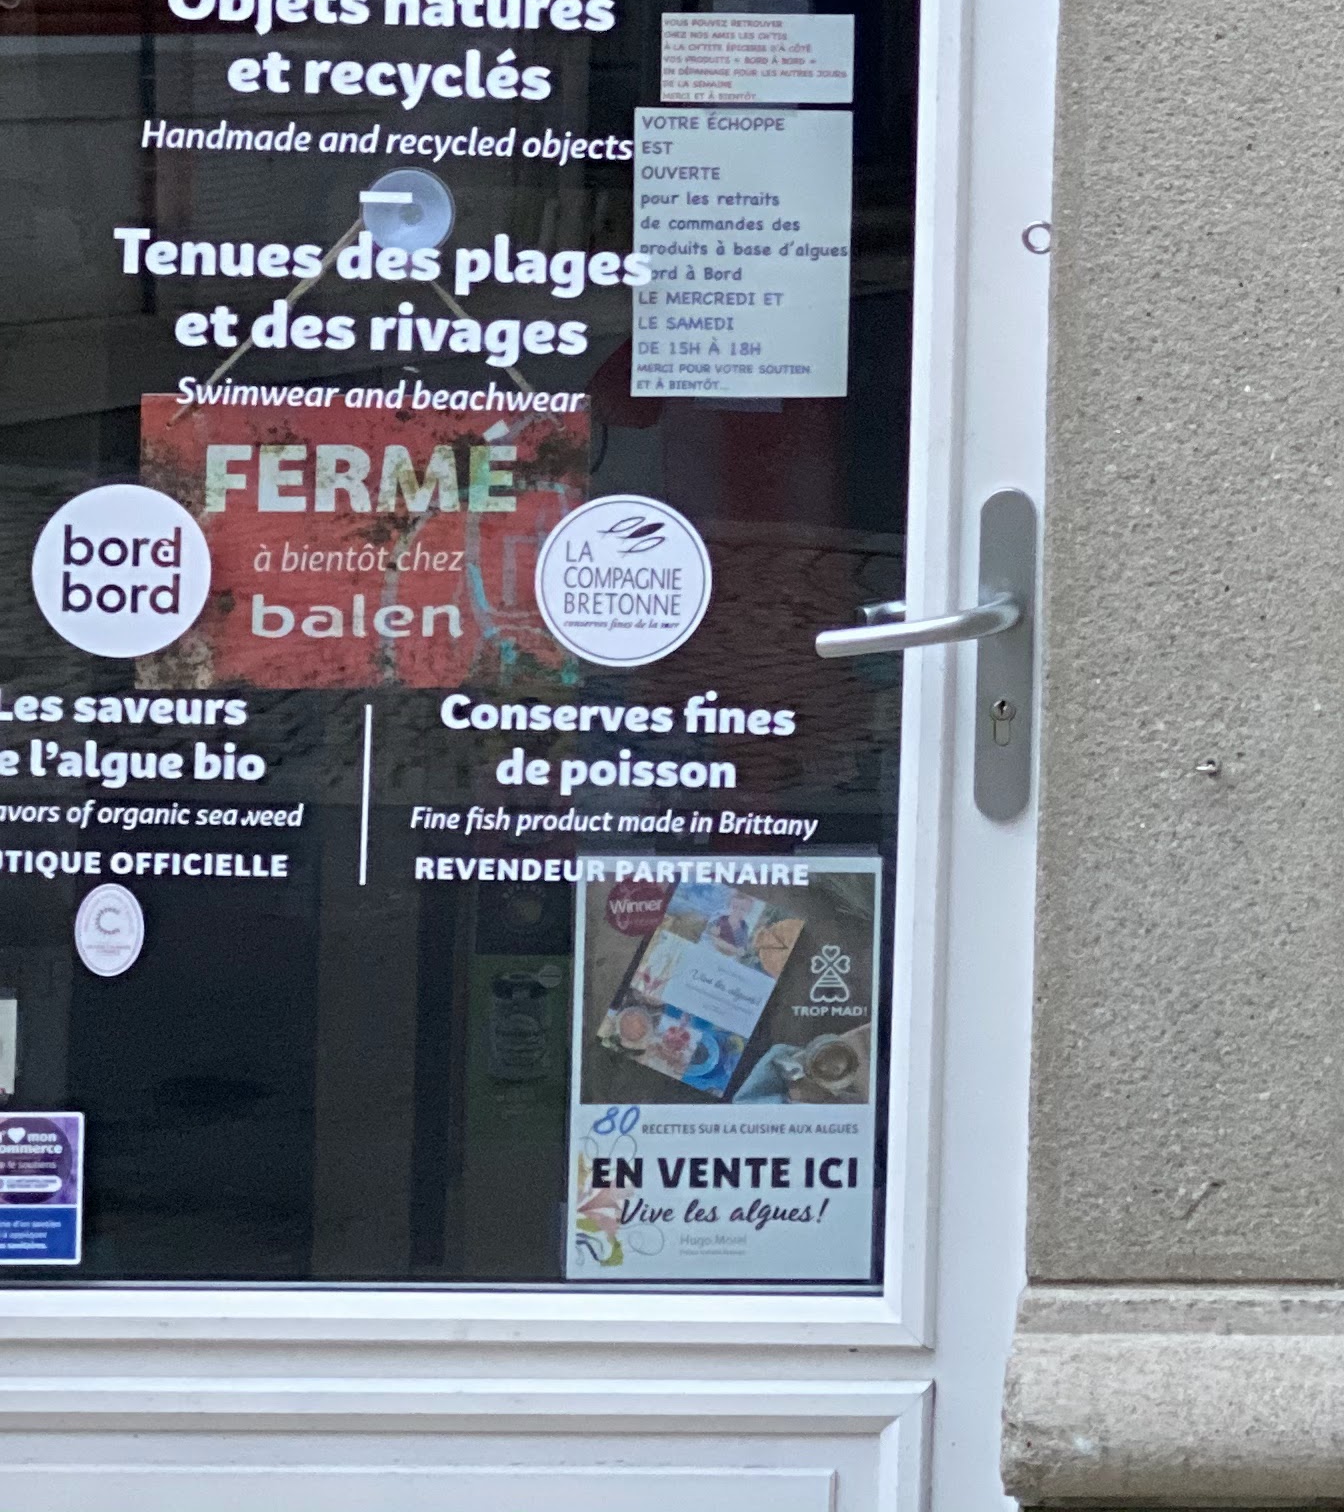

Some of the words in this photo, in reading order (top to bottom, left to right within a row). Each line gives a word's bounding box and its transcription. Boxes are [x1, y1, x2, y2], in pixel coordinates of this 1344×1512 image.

[227, 49, 289, 95] et
[304, 49, 552, 110] recyclés
[642, 116, 699, 130] VOTRE
[707, 112, 785, 131] ÉCHOPPE
[142, 119, 312, 155] Handmade
[319, 124, 380, 156] and
[387, 126, 515, 163] recycled
[521, 130, 634, 165] objects
[642, 141, 673, 155] EST
[641, 166, 721, 180] OUVERTE
[114, 226, 324, 279] Tenues
[337, 230, 441, 283] des
[455, 233, 654, 299] plages
[638, 292, 657, 305] LE
[666, 292, 756, 306] MERCREDI
[764, 292, 784, 306] ET
[174, 305, 238, 350] et
[251, 299, 356, 353] des
[370, 303, 588, 371] rivages
[638, 316, 657, 330] LE
[666, 316, 734, 331] SAMEDI
[175, 376, 338, 410] Swimwear
[339, 377, 404, 410] and
[410, 379, 586, 416] beachwear
[204, 421, 518, 515] FERMÉ
[63, 524, 182, 569] bord
[253, 543, 273, 572] à
[280, 542, 390, 572] bientôt
[397, 541, 465, 573] chez
[566, 540, 593, 562] LA
[62, 571, 180, 615] bord
[564, 566, 683, 590] COMPAGNIE
[251, 594, 463, 639] balen
[564, 592, 681, 616] BRETONNE
[73, 695, 248, 726] saveurs
[441, 694, 674, 734] Conserves
[683, 691, 796, 737] fines
[30, 740, 184, 789] l'algue
[194, 742, 266, 780] bio
[496, 748, 552, 789] de
[560, 752, 737, 797] poisson
[66, 800, 95, 829] of
[97, 803, 190, 830] organic
[410, 806, 461, 833] Fine
[465, 807, 509, 835] fish
[514, 809, 610, 841] product
[617, 811, 685, 836] made
[690, 812, 712, 836] in
[718, 812, 818, 841] Brittany
[110, 852, 288, 878] OFFICIELLE
[415, 857, 605, 886] REVENDEUR
[614, 859, 811, 888] PARTENAIRE
[609, 899, 663, 914] Winner
[792, 1006, 829, 1017] TROP
[593, 1106, 640, 1136] 80
[592, 1157, 643, 1189] EN
[657, 1157, 790, 1189] VENTE
[804, 1157, 858, 1189] ICI
[620, 1198, 674, 1224] Vive
[684, 1198, 719, 1223] les
[730, 1198, 830, 1231] algues!
